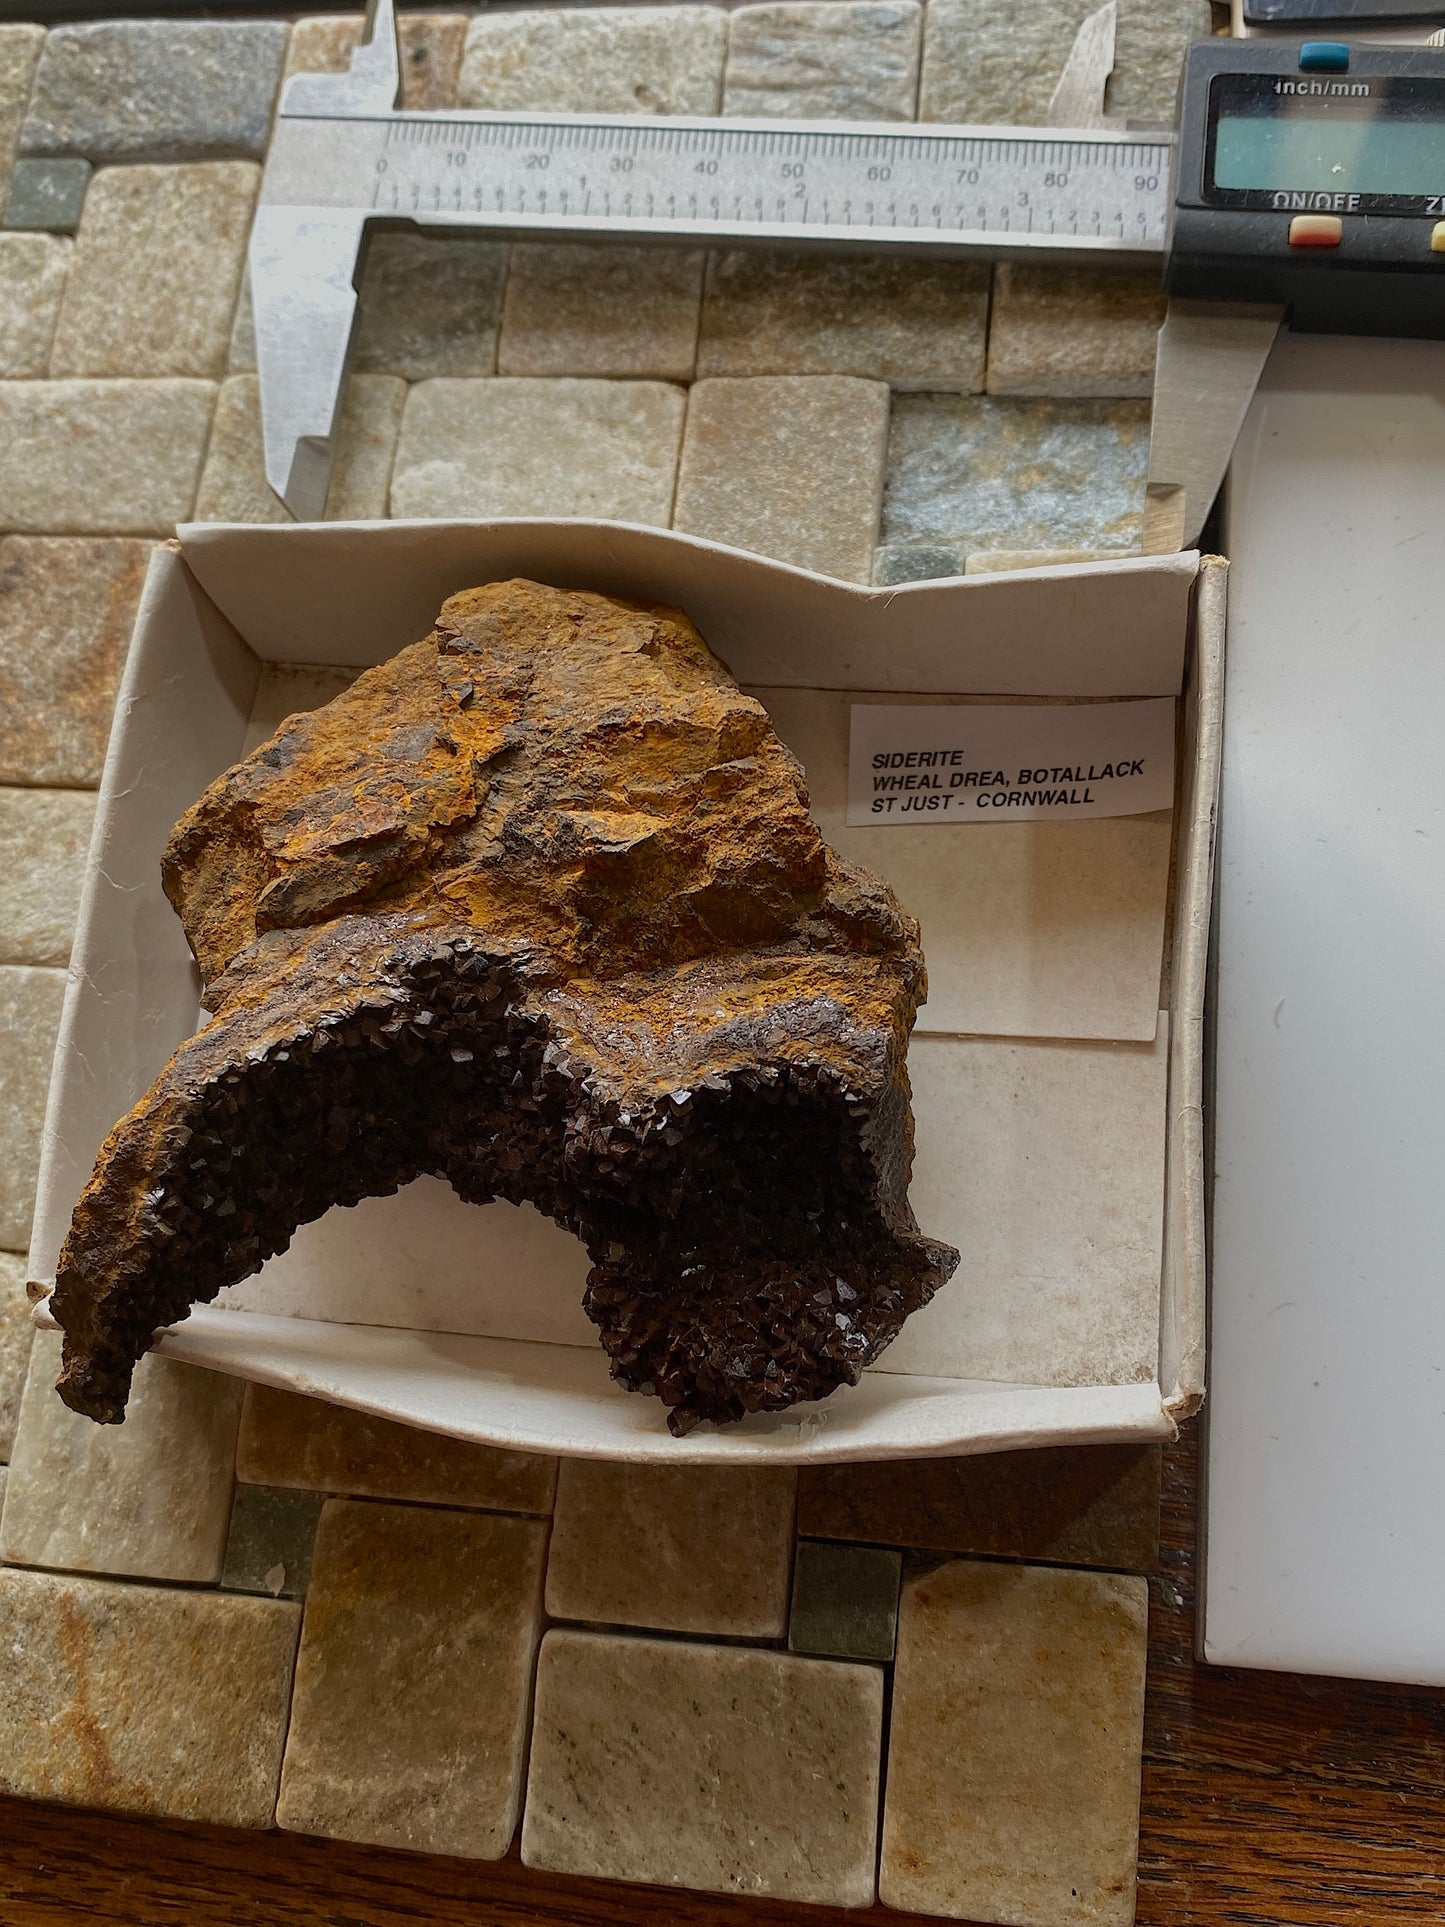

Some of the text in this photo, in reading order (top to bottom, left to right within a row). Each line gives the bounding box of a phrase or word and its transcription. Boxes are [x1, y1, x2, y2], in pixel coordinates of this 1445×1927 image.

[1273, 79, 1370, 96] inch/mm
[375, 151, 1158, 191] 0 10 20 30 40 50 60 70 80 90
[794, 182, 807, 199] 2
[1018, 191, 1030, 207] 3
[1272, 191, 1361, 212] ON/OFF
[872, 750, 964, 770] SIDERITE
[873, 759, 1146, 792] WHEAL DREA, BOTALLACK
[871, 797, 898, 813] ST
[901, 794, 954, 812] JUST
[976, 788, 1095, 808] CORNWALL
